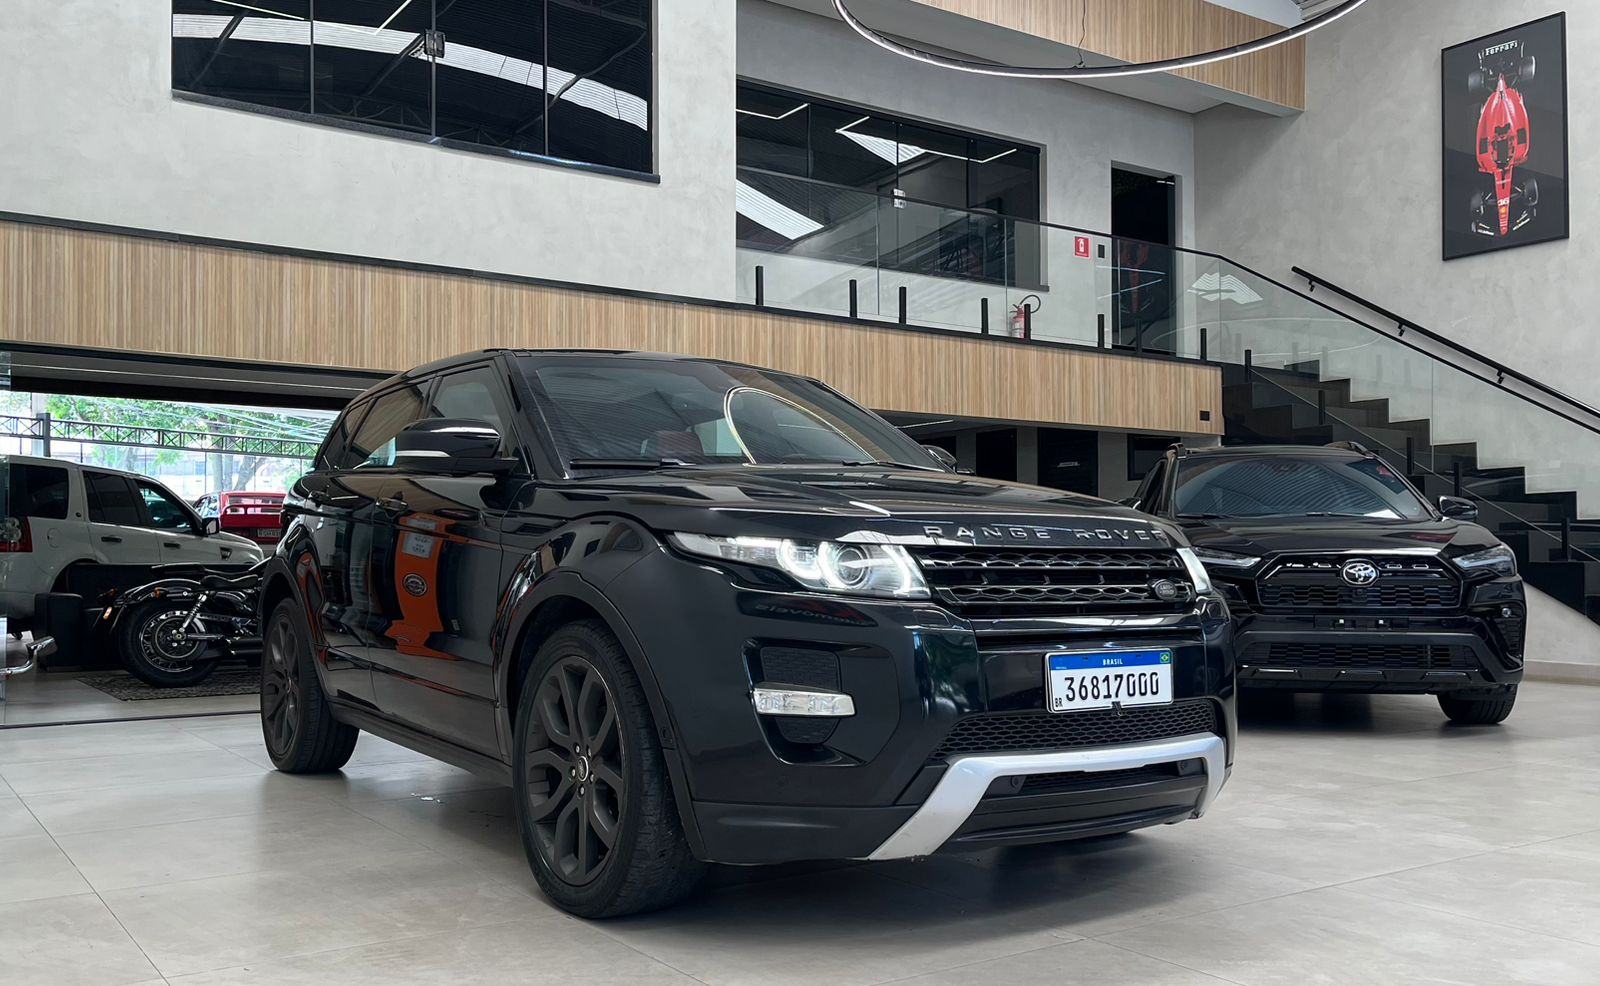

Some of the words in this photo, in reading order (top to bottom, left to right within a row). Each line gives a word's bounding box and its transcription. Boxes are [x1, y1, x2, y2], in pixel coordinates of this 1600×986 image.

[922, 525, 1052, 541] RANGE
[1074, 528, 1167, 541] ROVER
[1102, 658, 1123, 666] BRASIL
[1064, 672, 1159, 701] 36817000
[1055, 697, 1064, 708] BR
